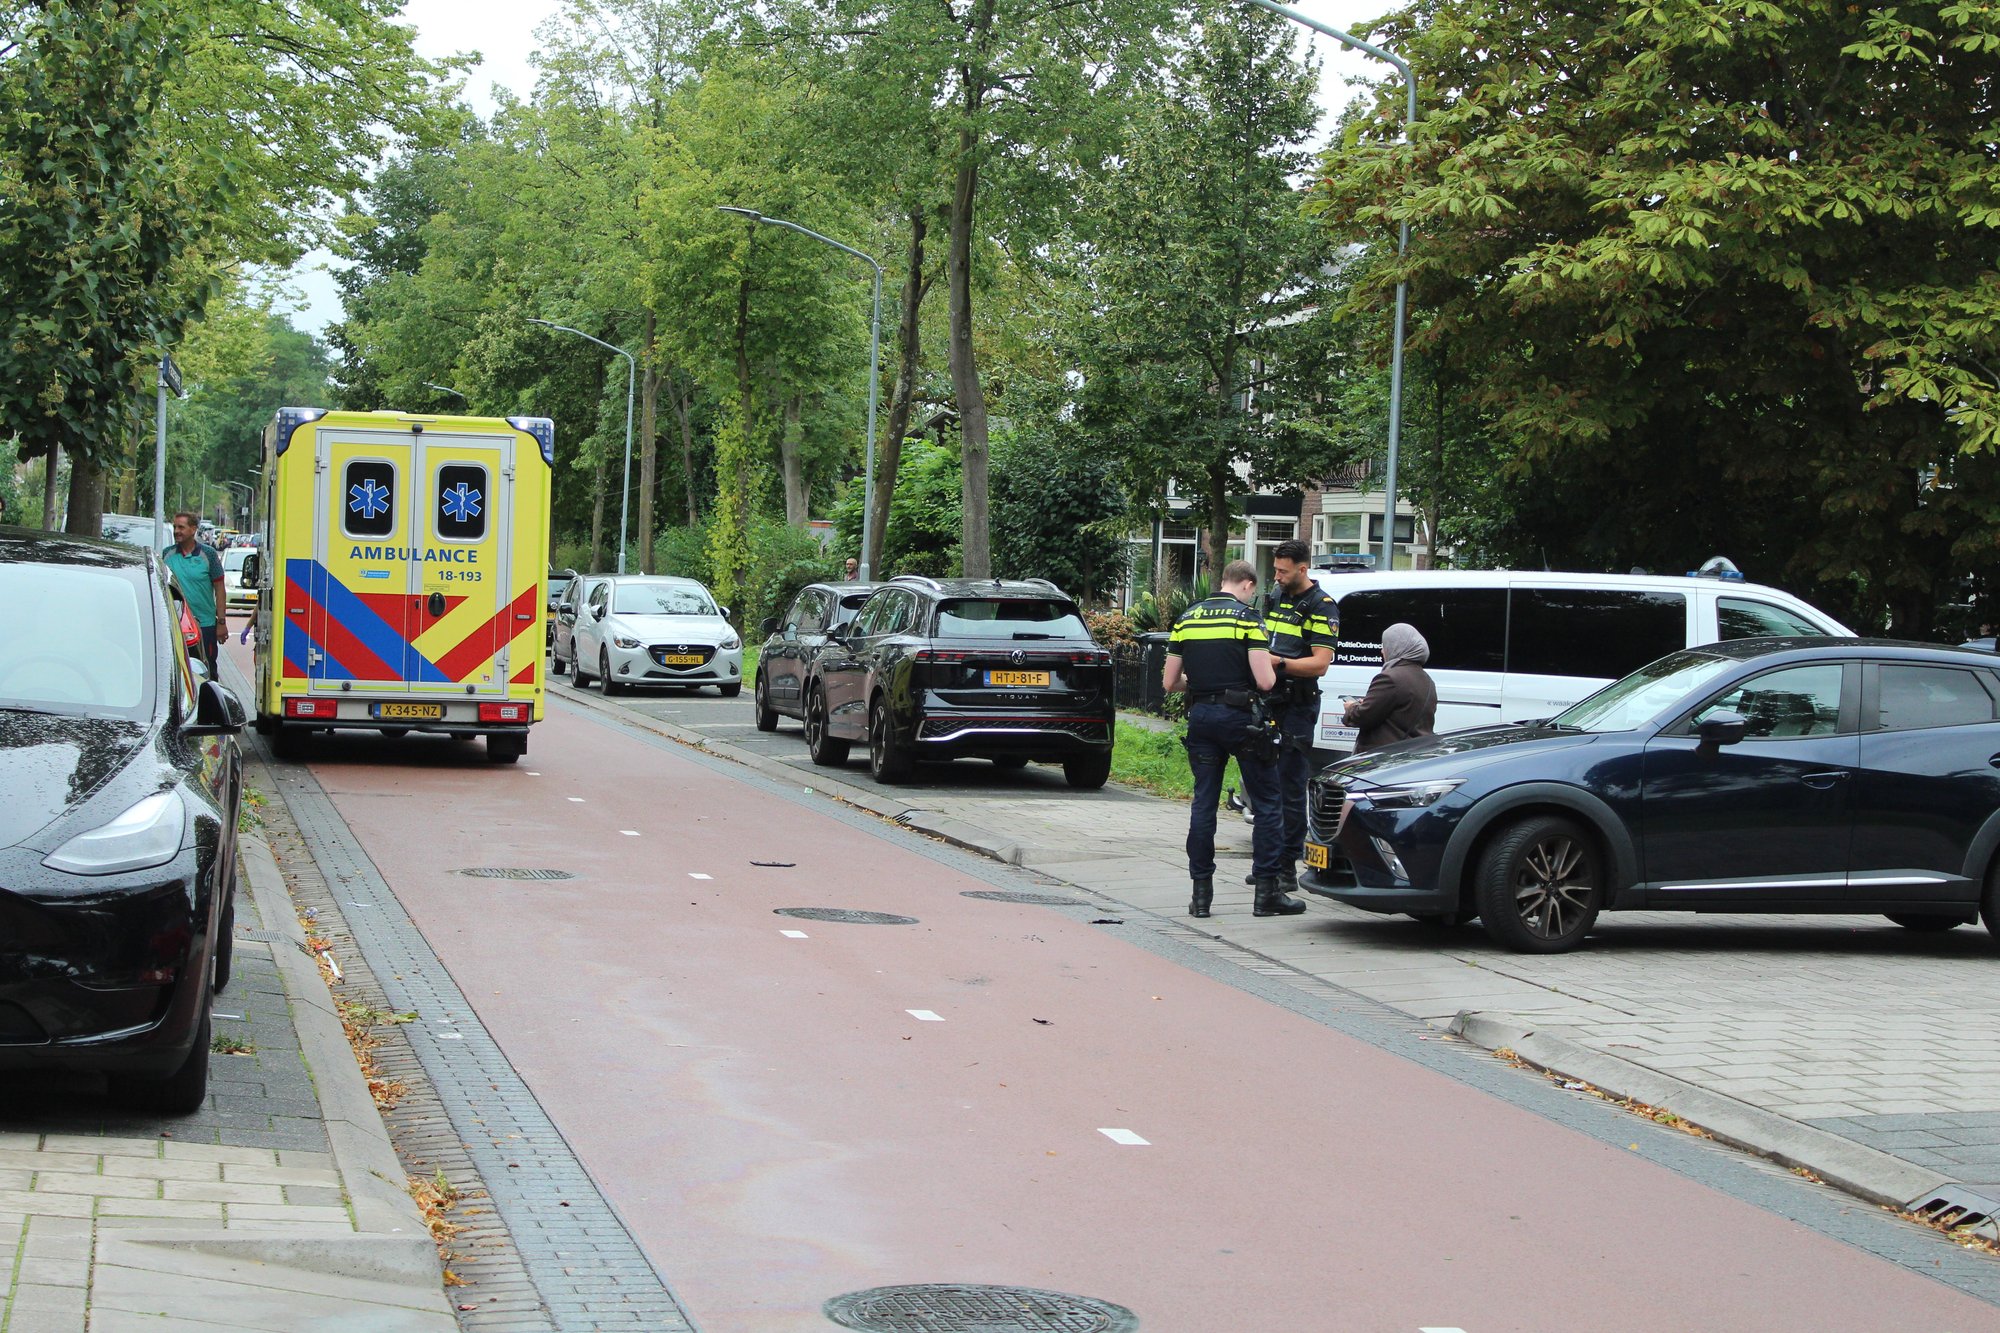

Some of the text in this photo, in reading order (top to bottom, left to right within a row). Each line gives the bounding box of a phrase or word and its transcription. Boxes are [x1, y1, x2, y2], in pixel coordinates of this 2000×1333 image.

[349, 546, 478, 563] AMBULANCE
[438, 570, 482, 582] 18-193
[668, 656, 701, 664] G-155-HL
[1337, 654, 1383, 663] Pol_Dordrecht
[995, 673, 1042, 684] HTJ-81-F
[385, 705, 438, 717] X-345-NZ
